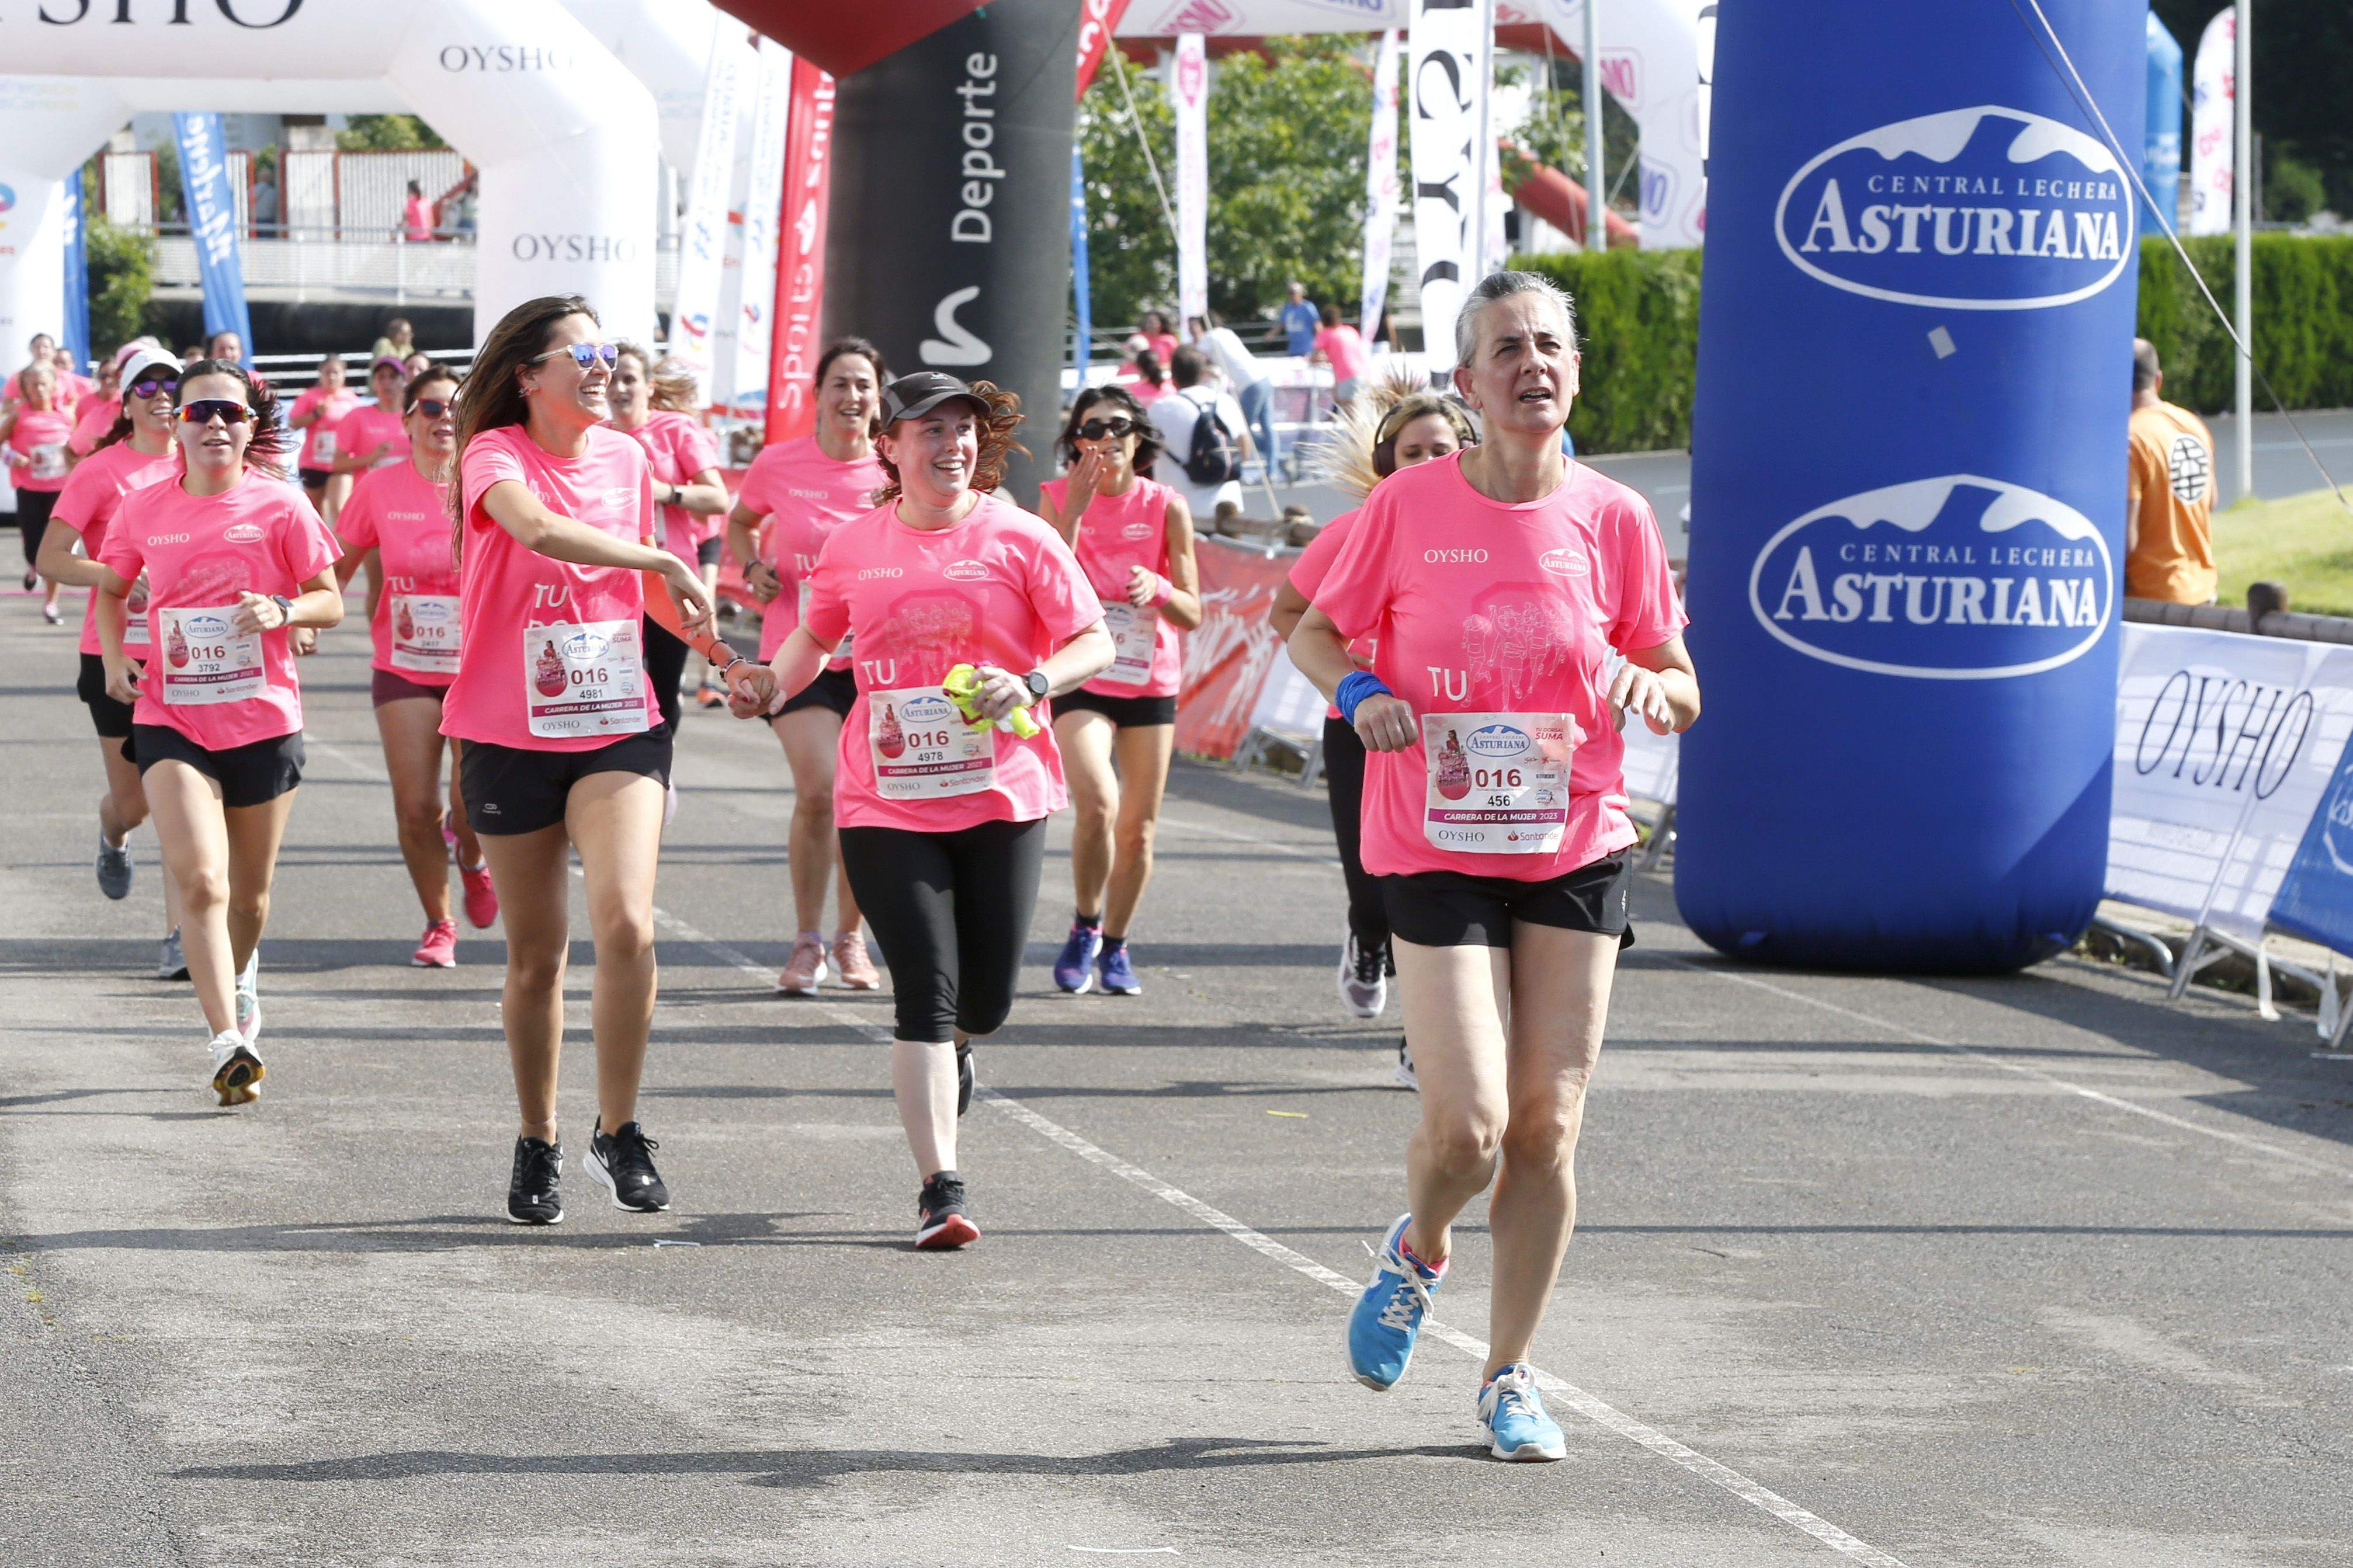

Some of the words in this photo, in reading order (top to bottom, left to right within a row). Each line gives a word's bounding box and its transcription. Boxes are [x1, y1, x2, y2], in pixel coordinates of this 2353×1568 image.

[952, 51, 1006, 244] Deporte
[1868, 175, 2004, 195] CENTRAL
[2018, 178, 2117, 200] LECHERA
[1800, 178, 2121, 260] ASTURIANA
[513, 233, 636, 263] OYSHO
[147, 533, 190, 546] OYSHO
[1424, 549, 1488, 564] OYSHO
[1840, 544, 1976, 565] CENTRAL
[1990, 548, 2095, 568] LECHERA
[858, 567, 904, 580] OYSHO
[388, 576, 414, 592] TU
[1774, 545, 2098, 627] ASTURIANA
[534, 584, 568, 609] TU
[192, 645, 225, 660] 016
[198, 663, 220, 672] 3792
[860, 658, 896, 686] TU
[571, 668, 609, 685] 016
[1427, 666, 1467, 701] TU
[579, 689, 603, 700] 4981
[544, 705, 578, 714] CARRERA
[904, 707, 948, 717] ASTURIANA
[543, 720, 580, 731] OYSHO
[908, 730, 949, 748] 016
[1535, 732, 1563, 740] SUMA
[2135, 670, 2313, 799] OYSHO
[1471, 736, 1525, 749] ASTURIANA
[918, 751, 944, 762] 4978
[1475, 769, 1522, 788] 016
[887, 782, 921, 791] OYSHO
[1487, 795, 1511, 806] 456
[1539, 812, 1558, 820] 2023
[1438, 830, 1485, 842] OYSHO
